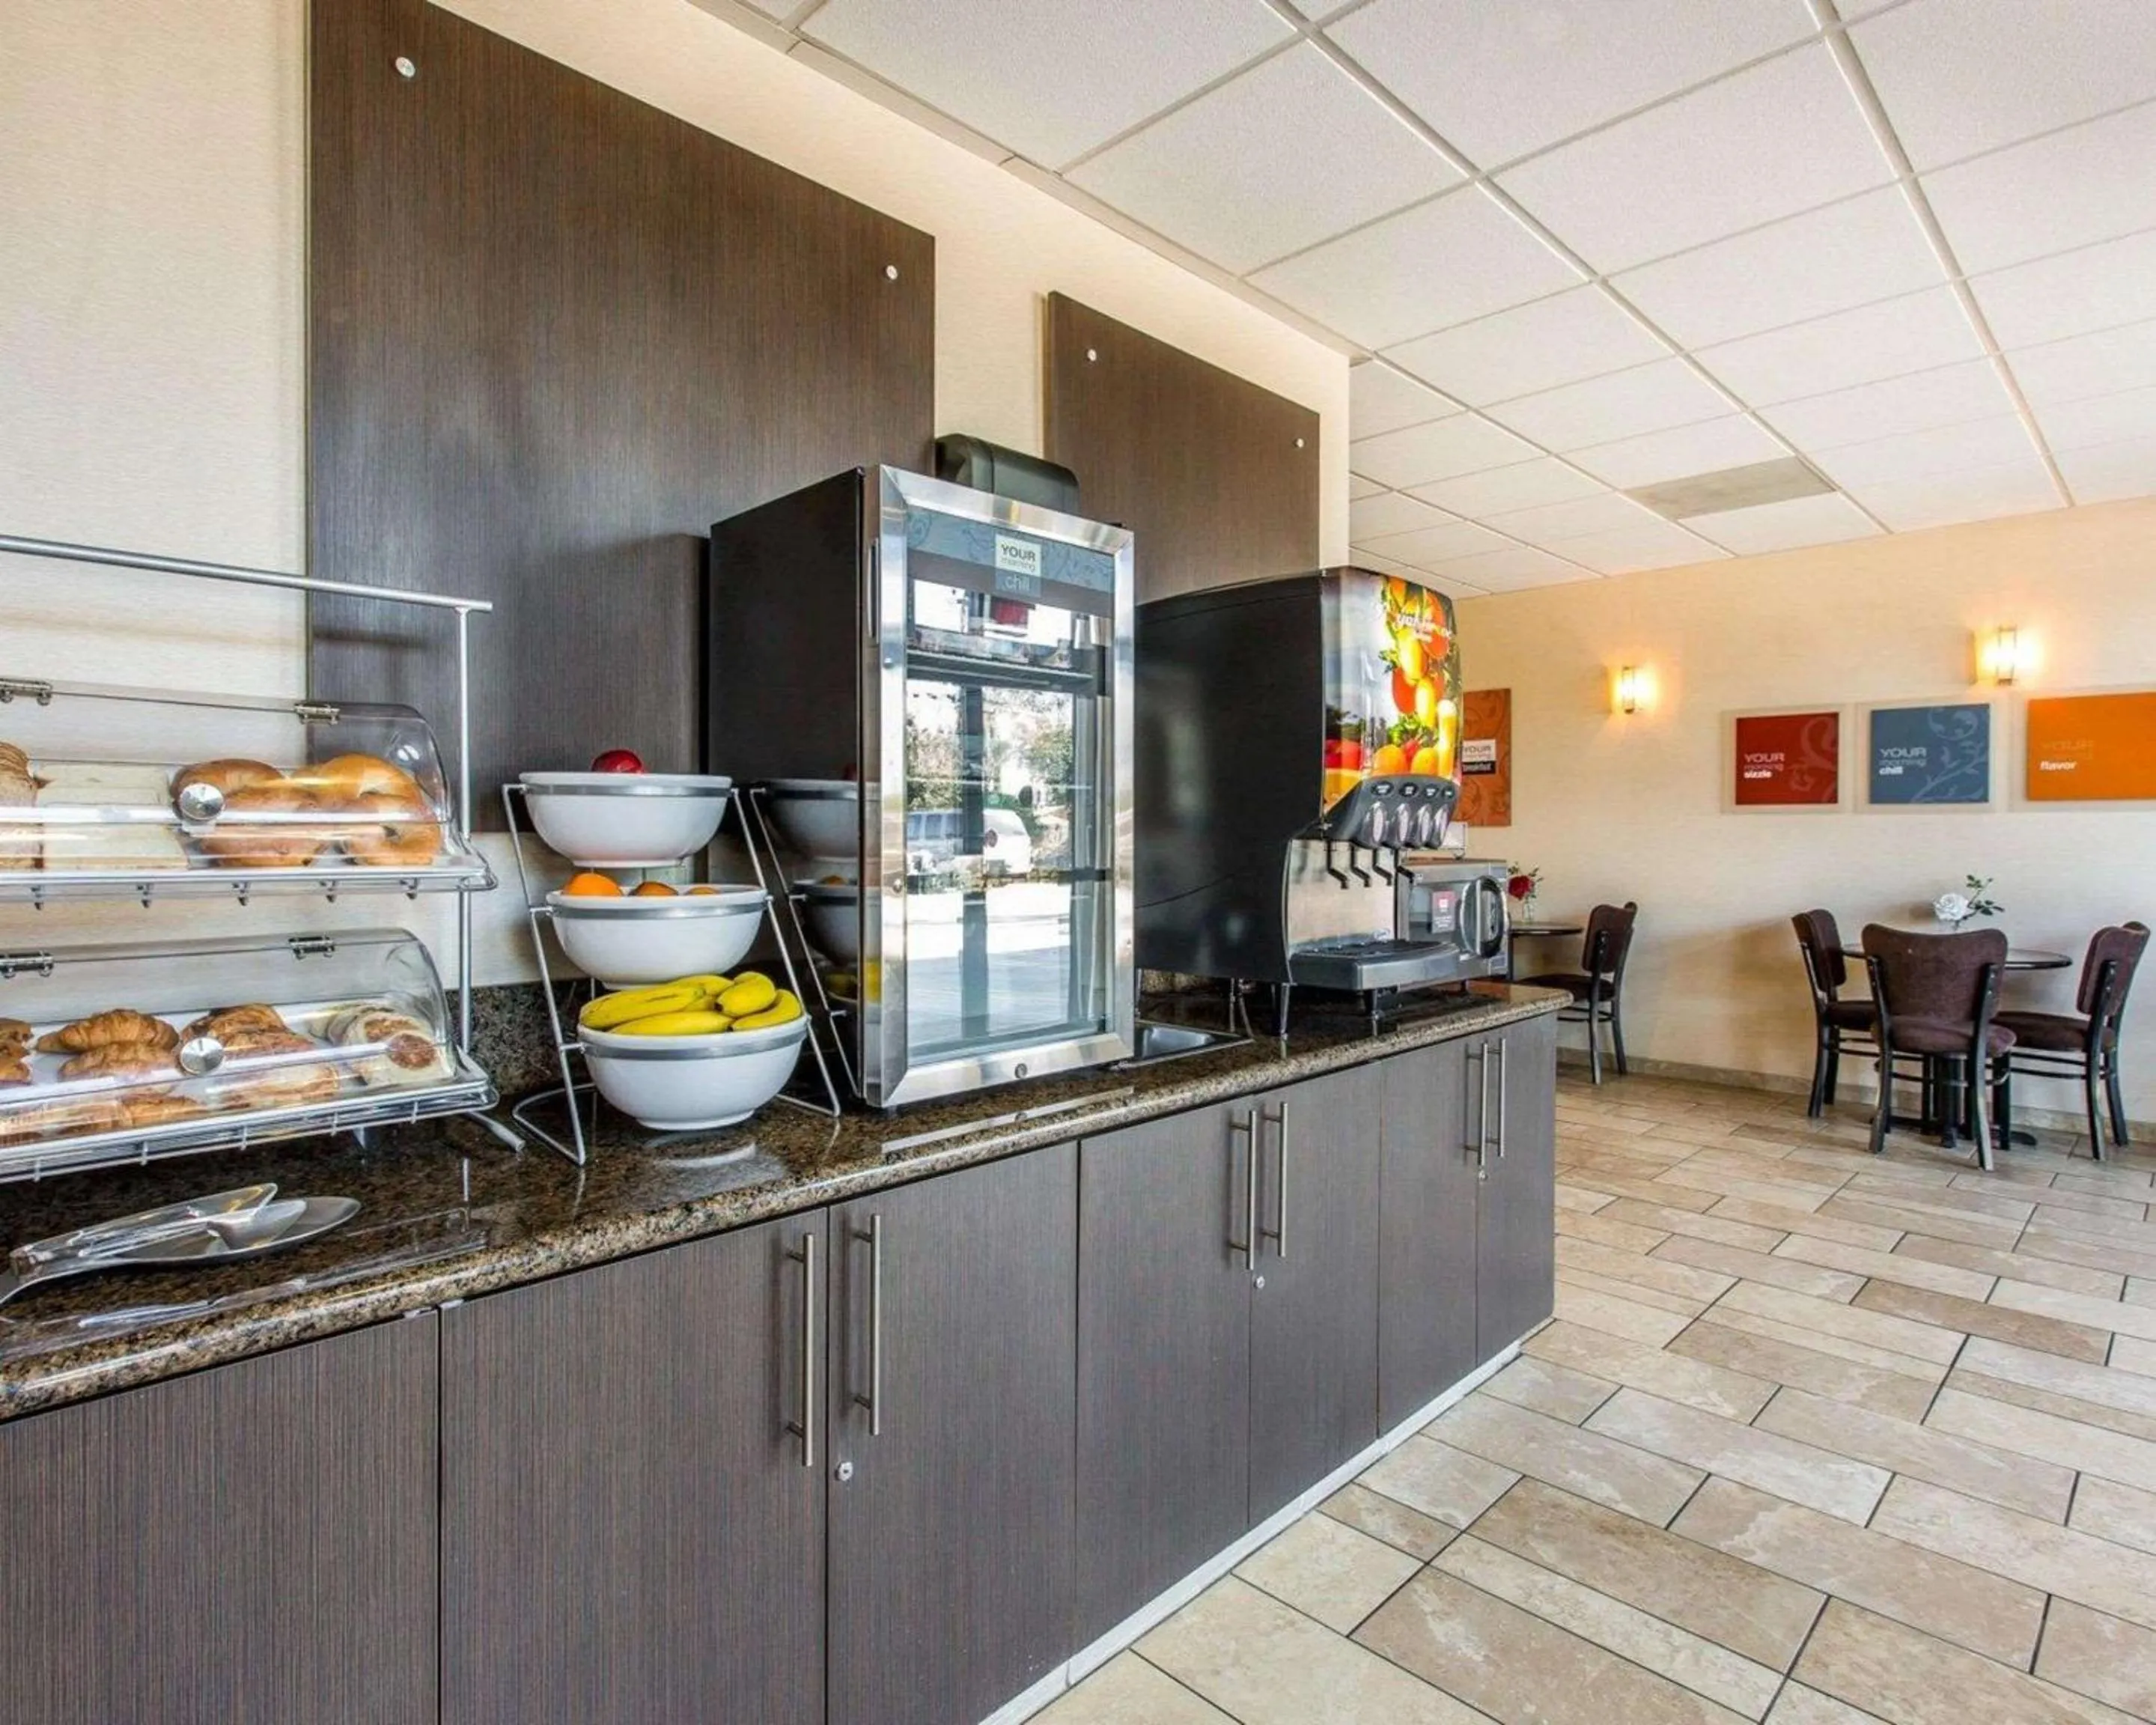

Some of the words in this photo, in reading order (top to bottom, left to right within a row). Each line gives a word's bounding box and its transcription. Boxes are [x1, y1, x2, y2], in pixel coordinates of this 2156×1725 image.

[1001, 544, 1036, 562] YOUR
[1005, 574, 1030, 591] chill
[1744, 752, 1785, 763] YOUR
[1880, 747, 1927, 758] YOUR
[1879, 766, 1903, 776] chill
